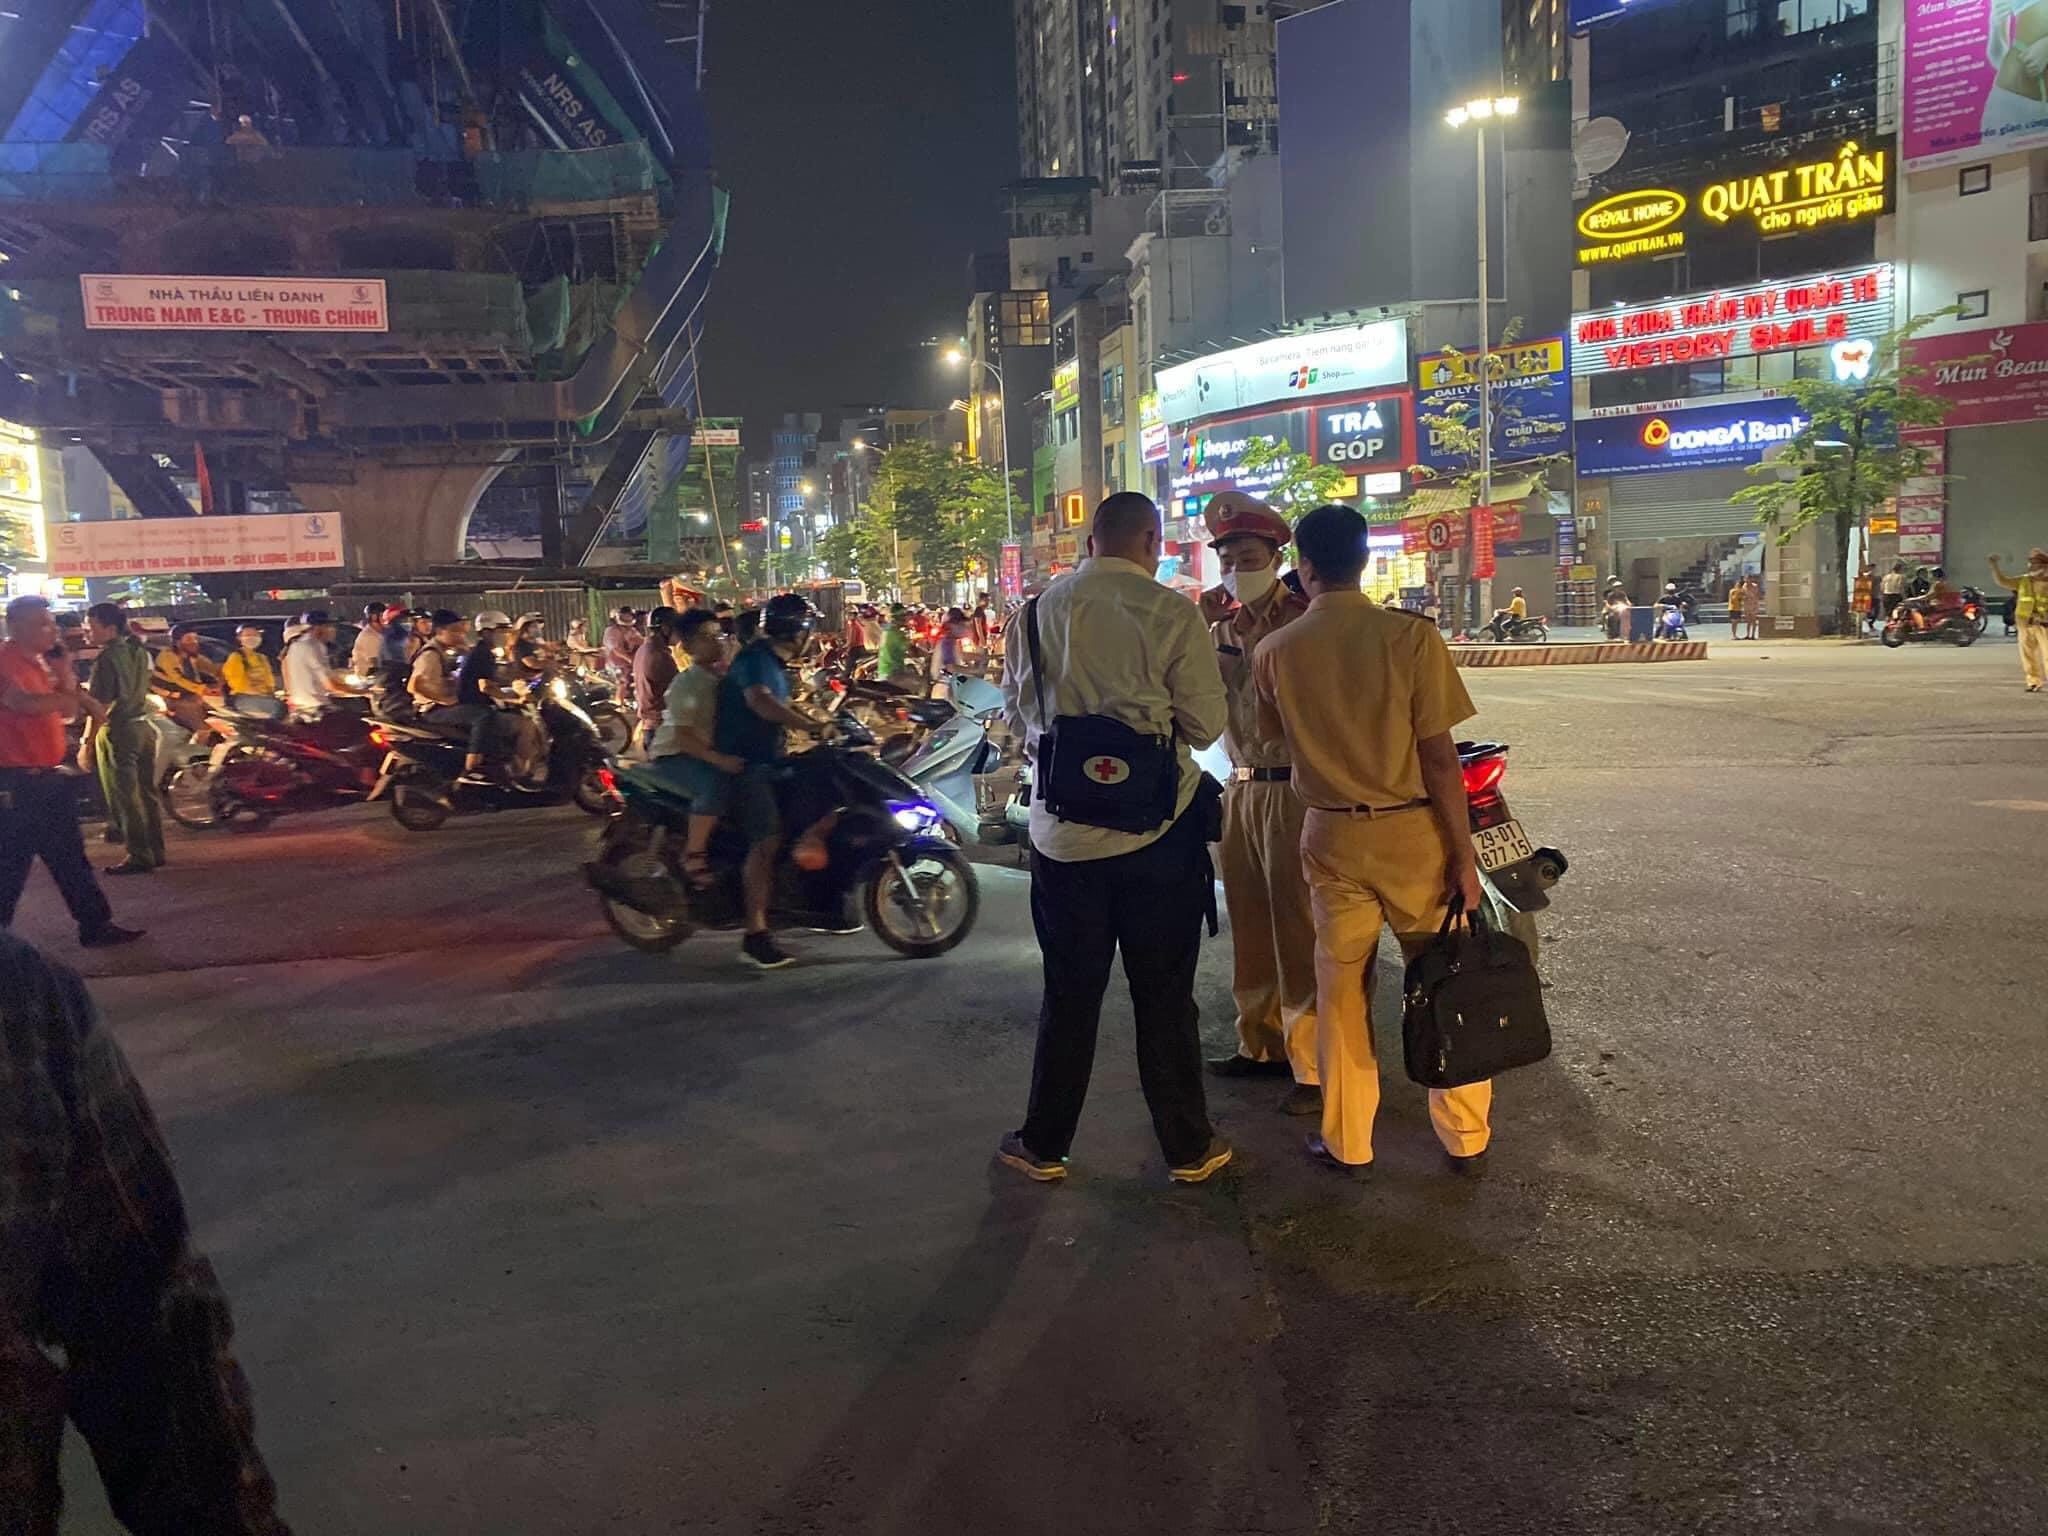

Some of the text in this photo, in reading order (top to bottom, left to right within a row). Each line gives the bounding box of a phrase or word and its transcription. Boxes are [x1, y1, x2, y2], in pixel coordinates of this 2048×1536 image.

[543, 73, 607, 147] NRS AS
[1796, 141, 1885, 197] TRẦN
[1588, 200, 1675, 230] ROYAL HOME
[1760, 192, 1884, 230] cho người giàu
[149, 285, 324, 303] NHÀ THẦU LIÊN DANH
[1622, 309, 1675, 337] KHOA
[1679, 290, 1739, 327] THẨM
[1743, 288, 1779, 318] MỸ
[1784, 277, 1845, 313] QUỐC
[1850, 267, 1883, 302] TẾ
[95, 305, 156, 323] TRUNG
[161, 306, 202, 324] NAM
[208, 307, 246, 324] E&C
[263, 308, 320, 325] TRUNG
[324, 306, 378, 326] CHÍNH
[1603, 313, 1848, 369] VICTORY SMILE
[1934, 365, 1988, 386] Mun
[1327, 401, 1384, 435] TRẢ
[1748, 416, 1809, 443] Bank
[1327, 434, 1384, 462] GÓP
[1476, 823, 1518, 850] 29-D1
[1481, 839, 1530, 868] 877.15
